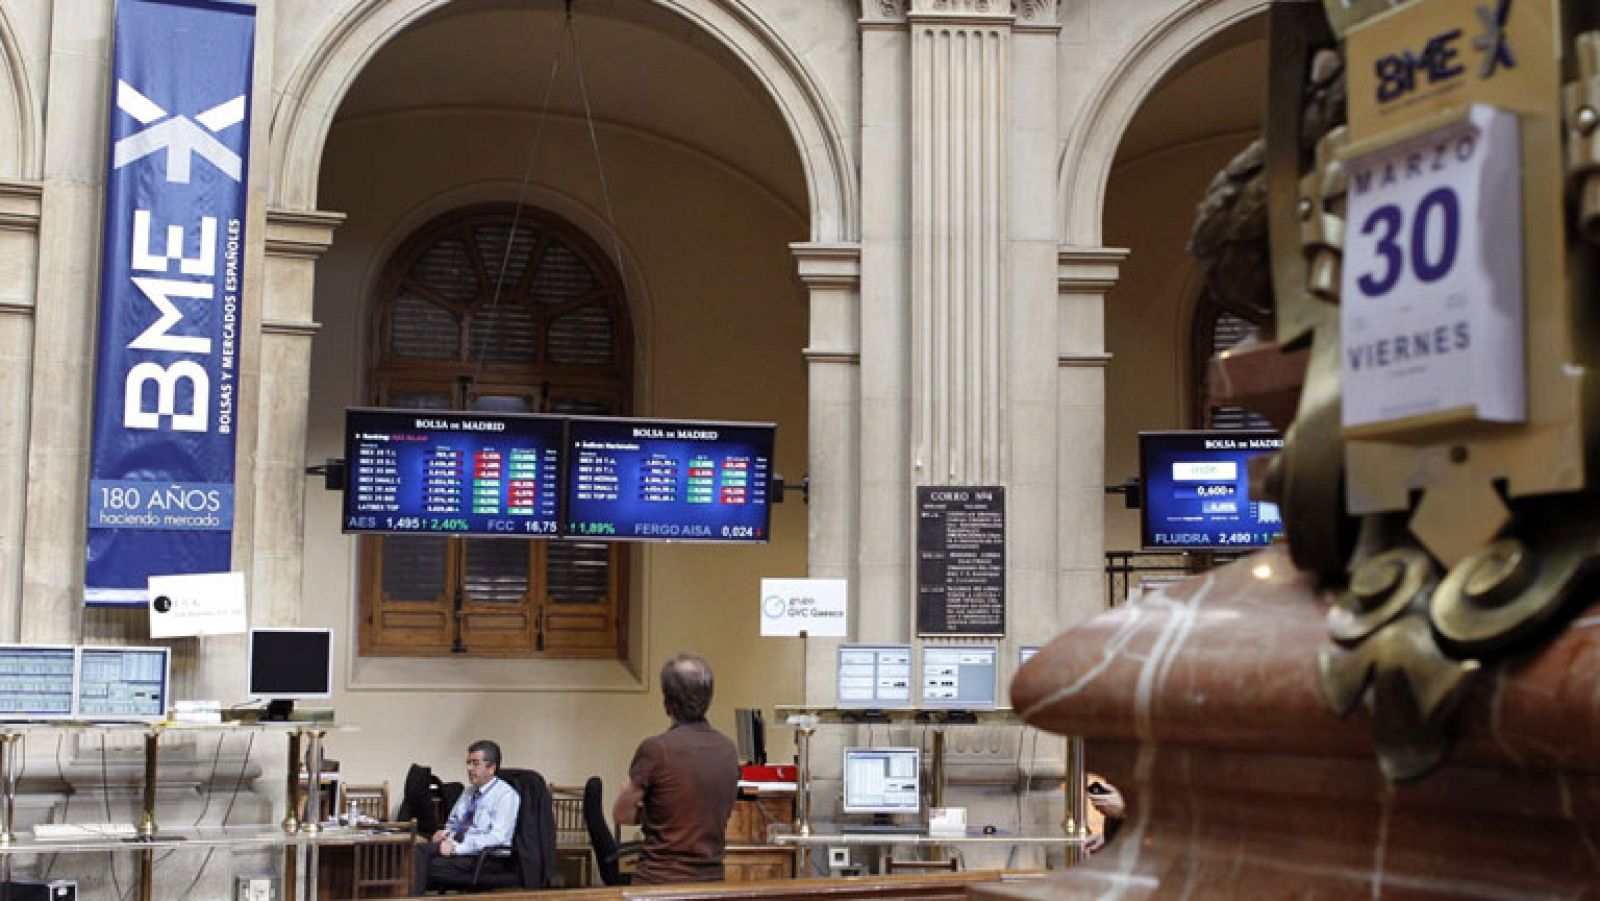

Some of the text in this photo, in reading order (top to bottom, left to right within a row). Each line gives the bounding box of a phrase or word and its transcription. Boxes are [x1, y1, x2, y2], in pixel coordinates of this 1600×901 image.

[1375, 27, 1465, 104] BME
[1352, 134, 1476, 196] MARZO
[225, 218, 241, 293] ESPAÑOLES
[1356, 185, 1462, 298] 30
[122, 209, 218, 433] BME
[222, 294, 237, 371] MERCADOS
[1347, 321, 1472, 372] VIERNES
[218, 386, 233, 434] BOLSAS
[415, 419, 449, 429] BOLSA
[462, 420, 505, 431] MADRID
[632, 427, 664, 437] BOLSA
[677, 429, 719, 440] MADRID
[1205, 439, 1237, 449] BOLSA
[100, 485, 220, 511] 180 AÑOS
[100, 510, 220, 527] haciendo mercado
[349, 517, 376, 527] AES
[487, 520, 515, 531] FCC
[634, 524, 679, 535] FERGO
[681, 525, 711, 536] AISA
[1155, 533, 1211, 543] FLUIDRA
